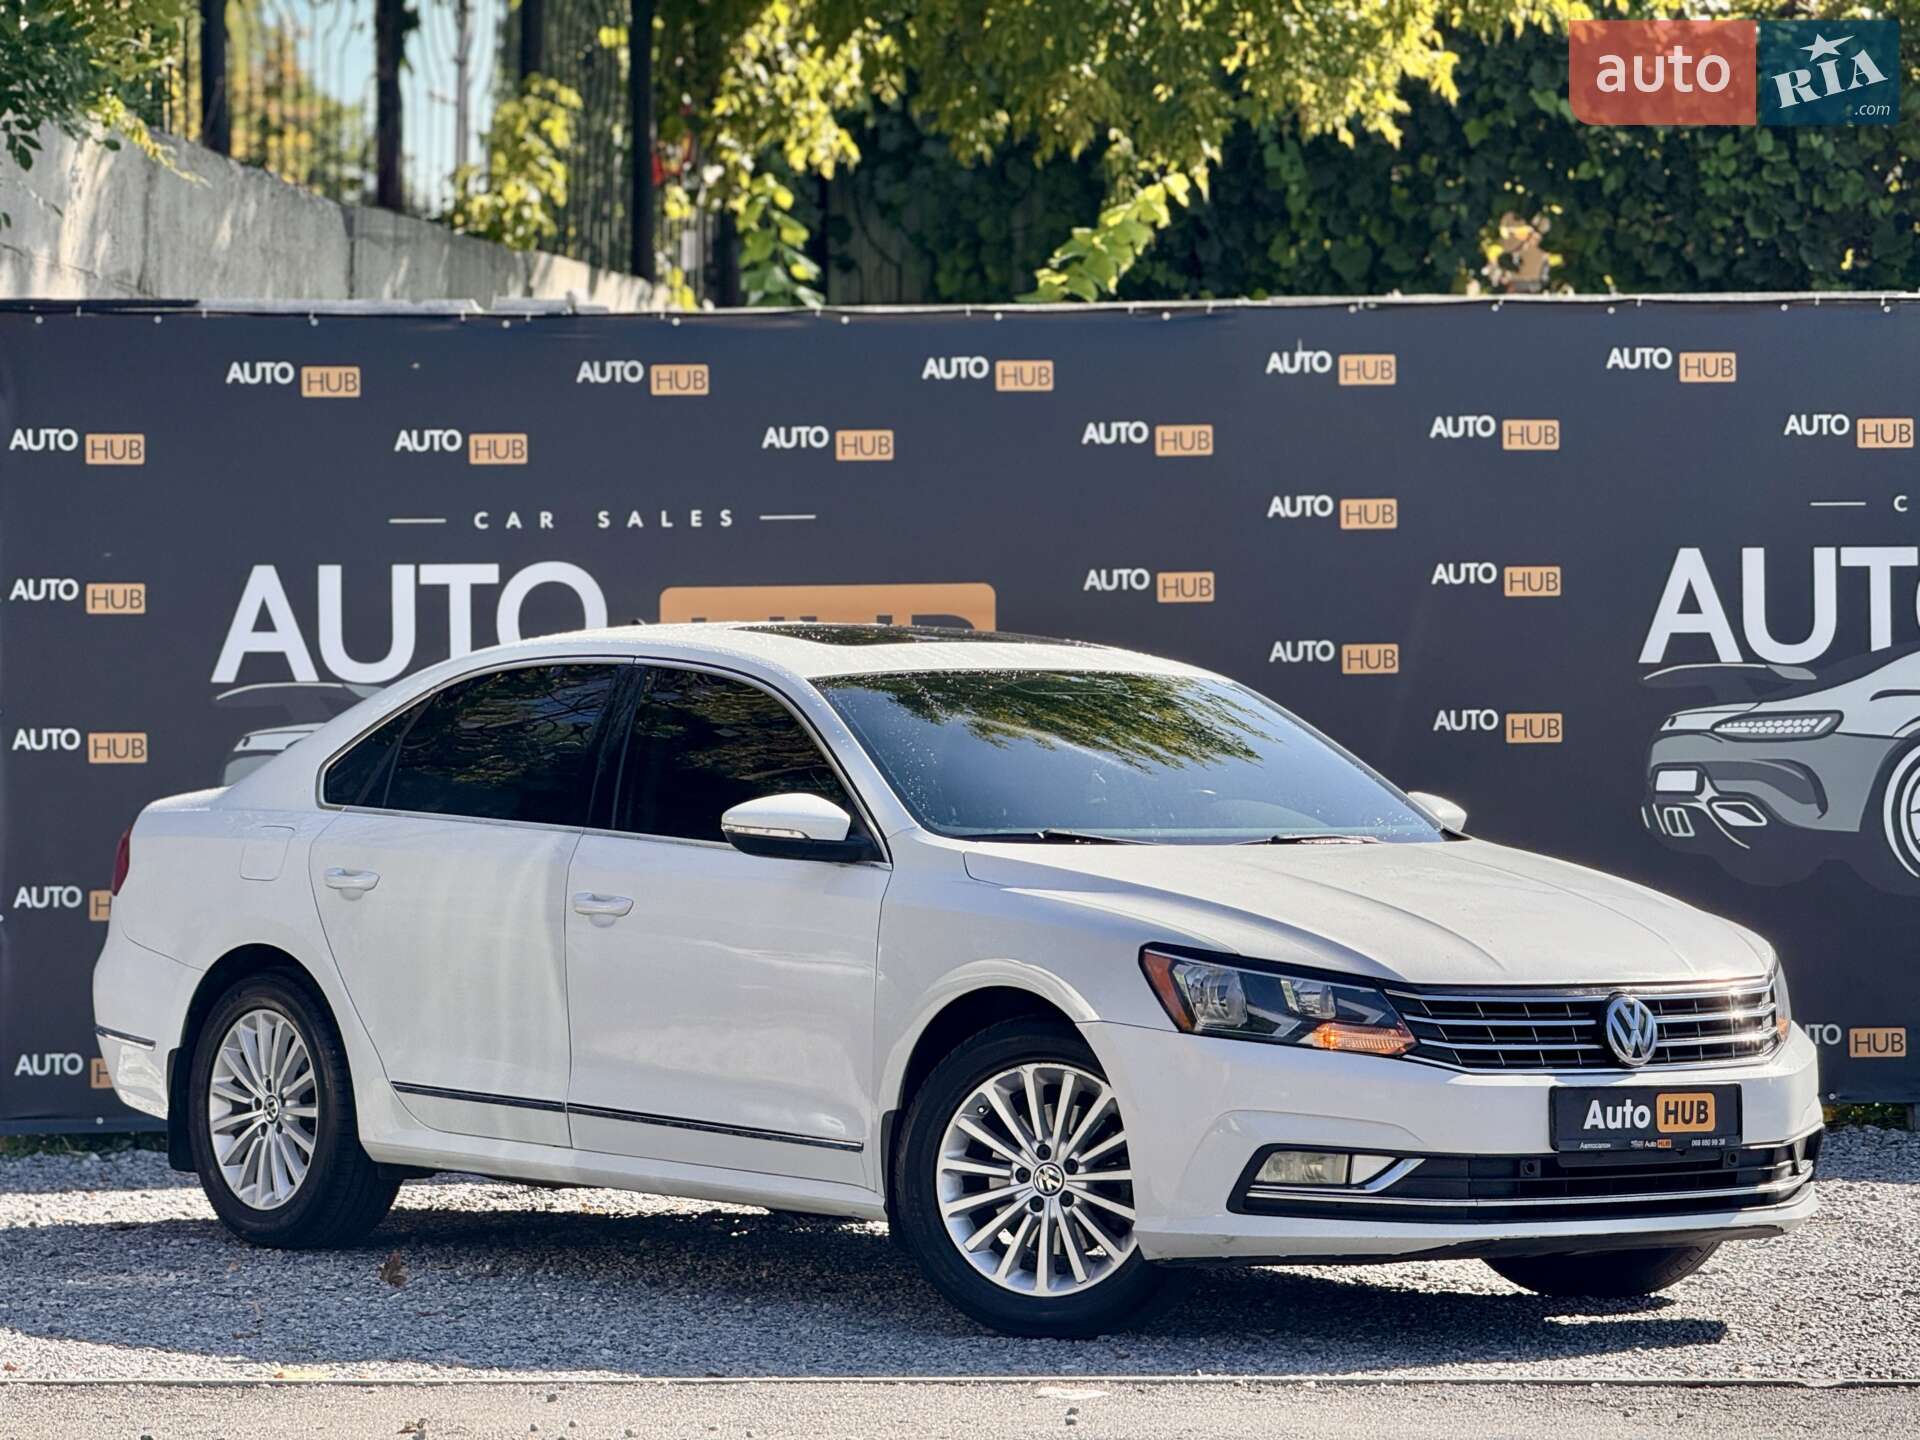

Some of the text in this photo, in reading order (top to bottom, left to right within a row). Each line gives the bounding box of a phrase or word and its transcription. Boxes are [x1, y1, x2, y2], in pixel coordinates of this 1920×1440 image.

[226, 361, 358, 393] AUTO HUB
[577, 361, 706, 391] AUTO HUB
[922, 357, 1051, 387] AUTO HUB
[1266, 351, 1393, 382] AUTO HUB
[1607, 348, 1734, 378] AUTO HUB
[10, 428, 141, 461] AUTO HUB
[394, 430, 525, 460] AUTO HUB
[762, 426, 891, 457] AUTO HUB
[1082, 421, 1211, 452] AUTO HUB
[1430, 415, 1557, 446] AUTO HUB
[1784, 414, 1912, 445] AUTO HUB
[474, 510, 733, 529] CAR SALES
[1267, 495, 1395, 525] AUTO HUB
[1084, 568, 1213, 599] AUTO HUB
[1432, 563, 1559, 593] AUTO HUB
[10, 578, 143, 610] AUTO HUB
[1639, 547, 1920, 664] AUT
[211, 561, 608, 683] AUTO
[1270, 640, 1397, 671] AUTO HUB
[1434, 709, 1561, 740] AUTO HUB
[12, 728, 144, 759] AUTO HUB
[14, 886, 82, 908] AUTO
[1805, 1024, 1904, 1053] TO HUB
[15, 1053, 83, 1075] AUTO
[1584, 1099, 1709, 1129] Auto HUB
